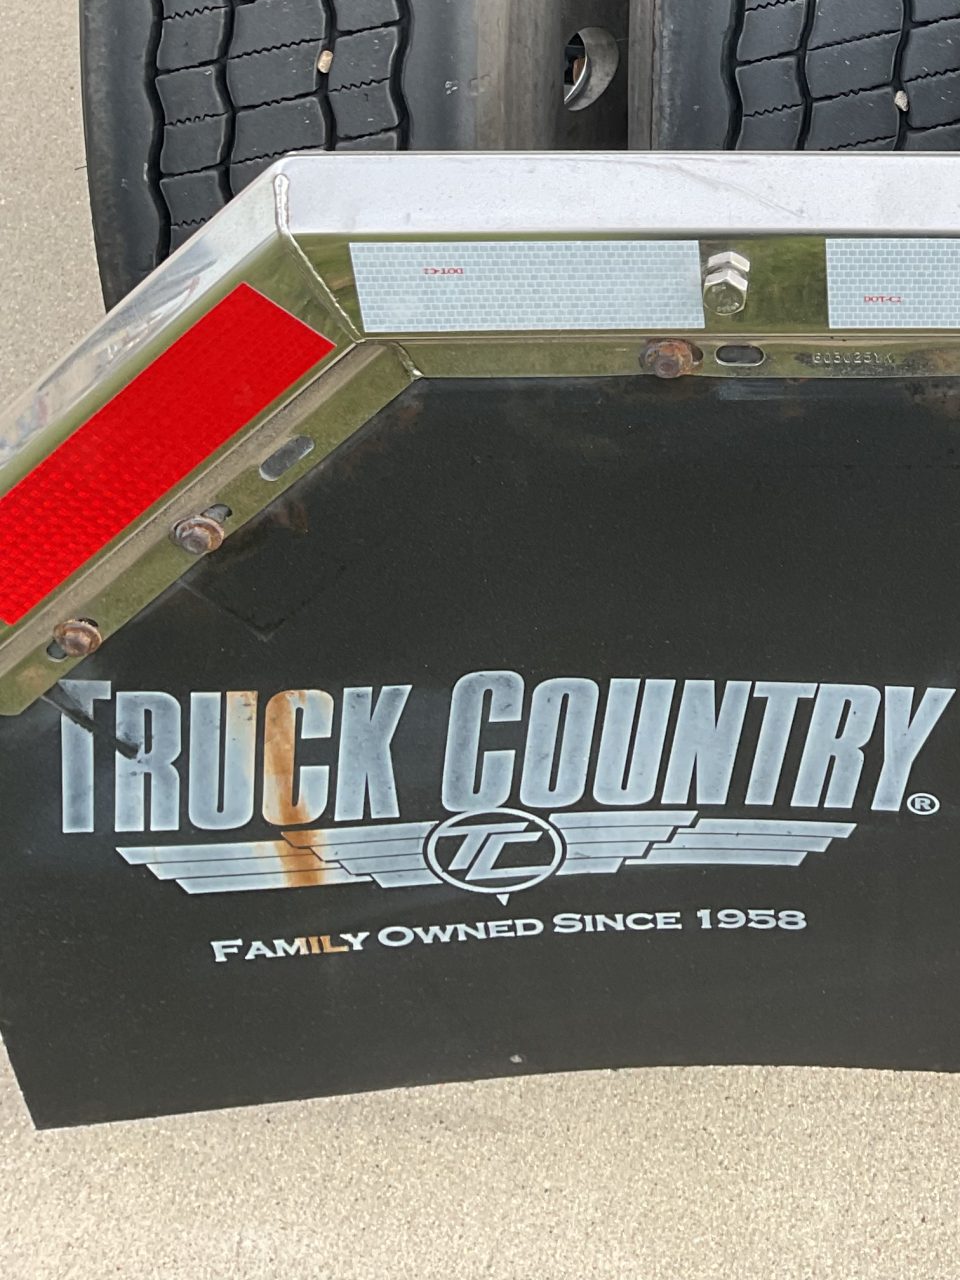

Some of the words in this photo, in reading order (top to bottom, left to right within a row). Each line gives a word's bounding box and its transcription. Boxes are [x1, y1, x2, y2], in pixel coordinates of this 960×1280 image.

[58, 680, 412, 833] TRUCK
[442, 671, 956, 812] COUNTRY
[210, 932, 370, 962] FAMILY
[378, 919, 545, 947] OWNED
[552, 912, 682, 933] SINCE
[697, 909, 807, 930] 1958
